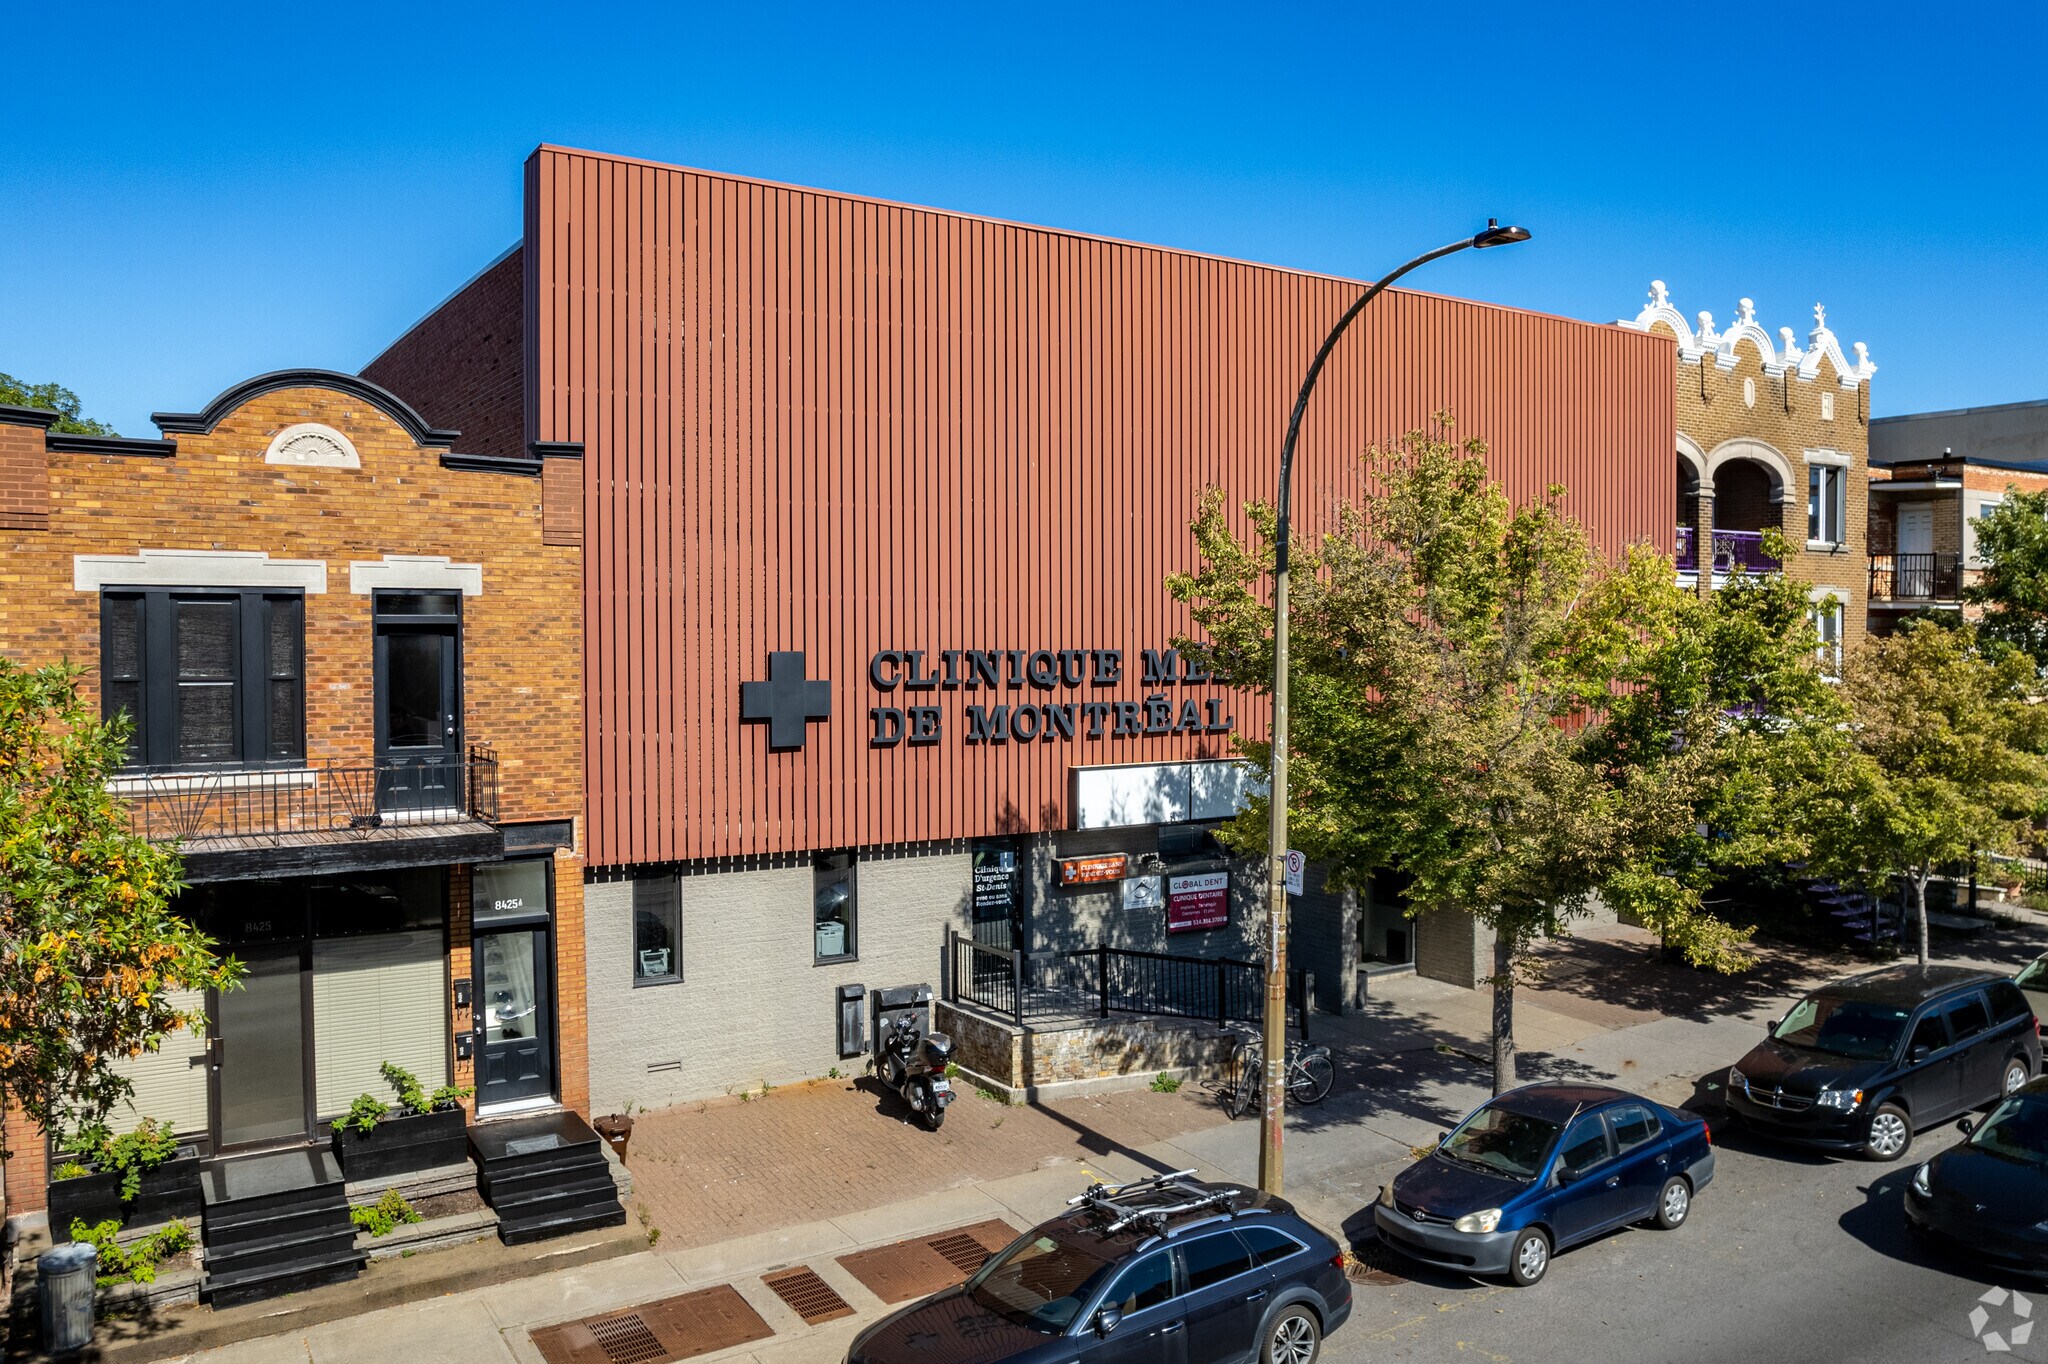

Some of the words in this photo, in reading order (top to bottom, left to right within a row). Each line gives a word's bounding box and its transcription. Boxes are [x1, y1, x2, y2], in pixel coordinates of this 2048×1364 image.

[871, 649, 1122, 687] CLINIQUE
[1142, 641, 1233, 682] MÉ
[871, 706, 943, 744] DE
[967, 692, 1234, 740] MONTRÉAL
[974, 873, 1010, 883] D'urgence
[1173, 880, 1203, 889] GLOBAL
[1204, 877, 1223, 887] DENT
[1173, 893, 1198, 902] CLINIQUE
[1198, 890, 1223, 899] DENTAIRE
[244, 920, 272, 931] 8425
